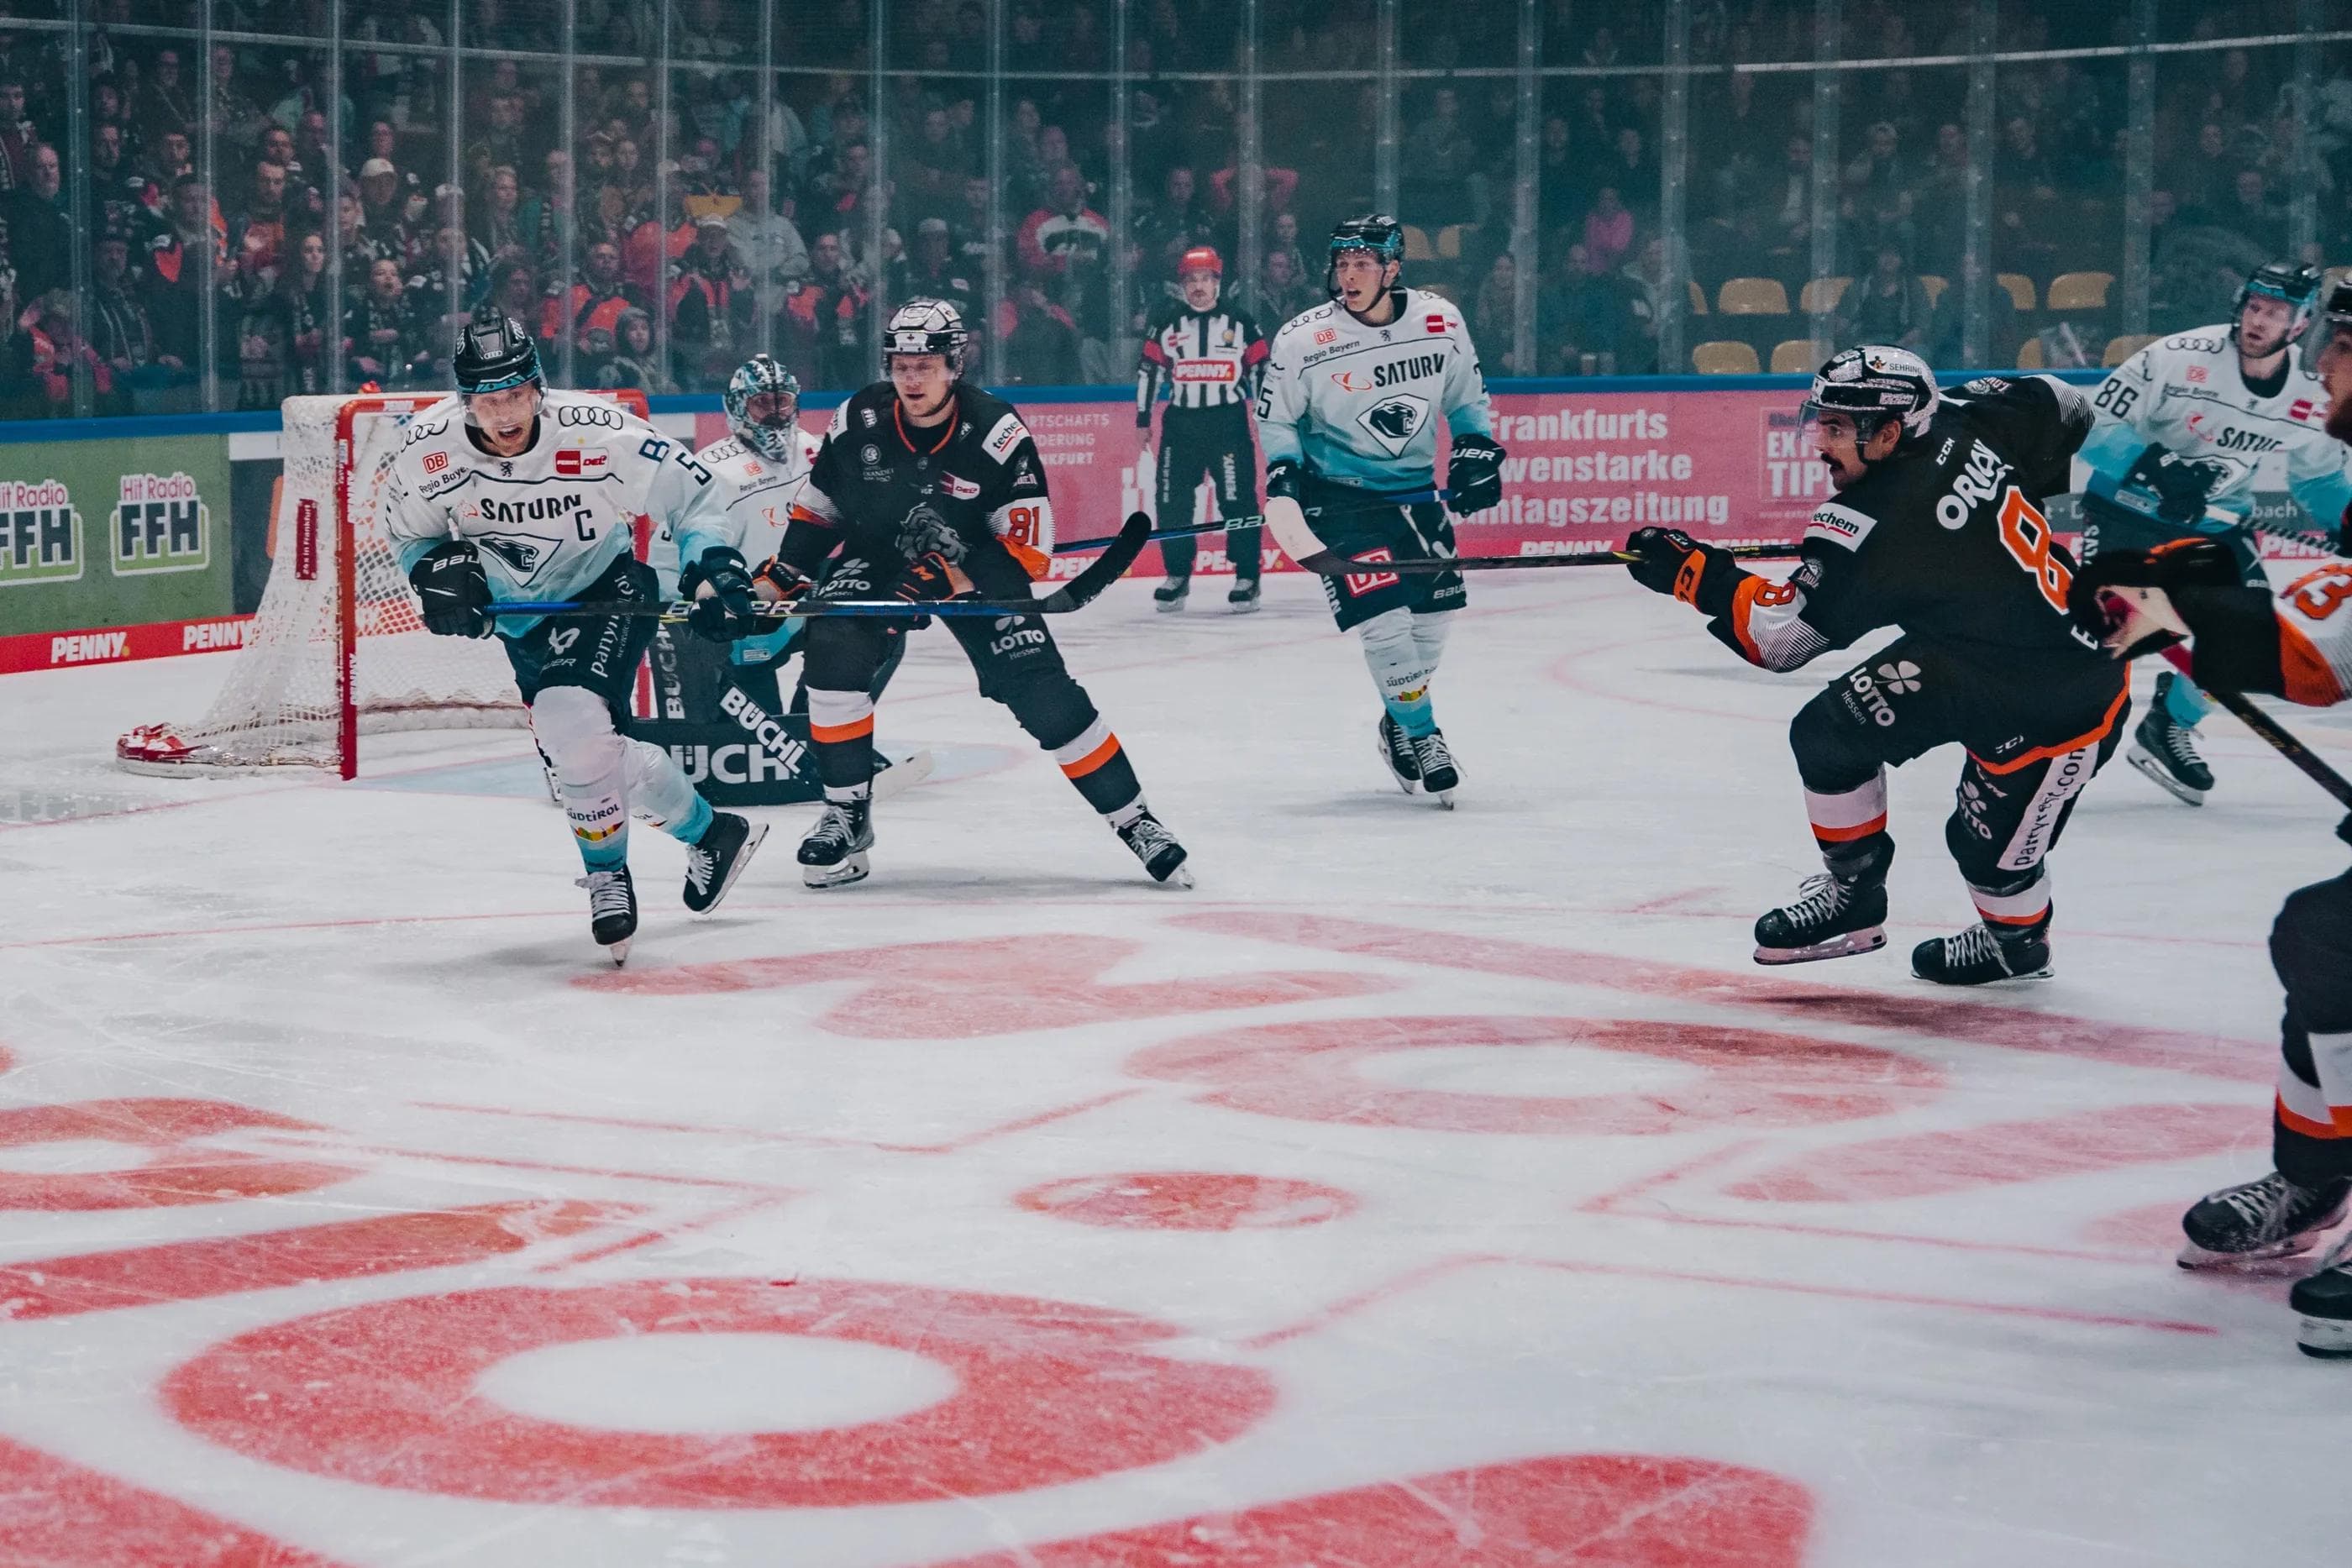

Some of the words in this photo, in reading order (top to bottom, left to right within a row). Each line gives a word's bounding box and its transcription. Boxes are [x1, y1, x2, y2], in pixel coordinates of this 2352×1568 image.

[1303, 350, 1327, 364] Regio
[1329, 340, 1360, 354] Bayern
[1176, 364, 1231, 378] PENNY
[1889, 363, 1922, 375] SEHRING
[2094, 378, 2139, 418] 86
[992, 420, 1018, 449] teche
[1022, 413, 1110, 428] RTSCHAFTS
[1032, 433, 1095, 447] DERUNG
[1936, 437, 1956, 465] CCM
[1452, 448, 1495, 461] UER
[1501, 451, 1693, 485] wenstarke
[3, 485, 11, 508] it
[17, 483, 66, 507] Radio
[123, 478, 143, 501] Hit
[148, 475, 193, 499] Radio
[480, 494, 581, 523] SATURN
[2251, 500, 2297, 518] bach
[120, 501, 199, 557] FFH
[575, 509, 596, 541] C
[1009, 506, 1039, 546] 81
[1814, 512, 1860, 535] echem
[51, 632, 127, 663] PENNY
[182, 620, 256, 651] PENNY
[990, 629, 1046, 655] LOTTO
[1009, 647, 1042, 660] Hessen
[1841, 690, 1867, 725] Hessen
[1849, 666, 1896, 727] LOTTO
[720, 686, 806, 774] BÜCHL
[669, 742, 806, 784] ÜCH
